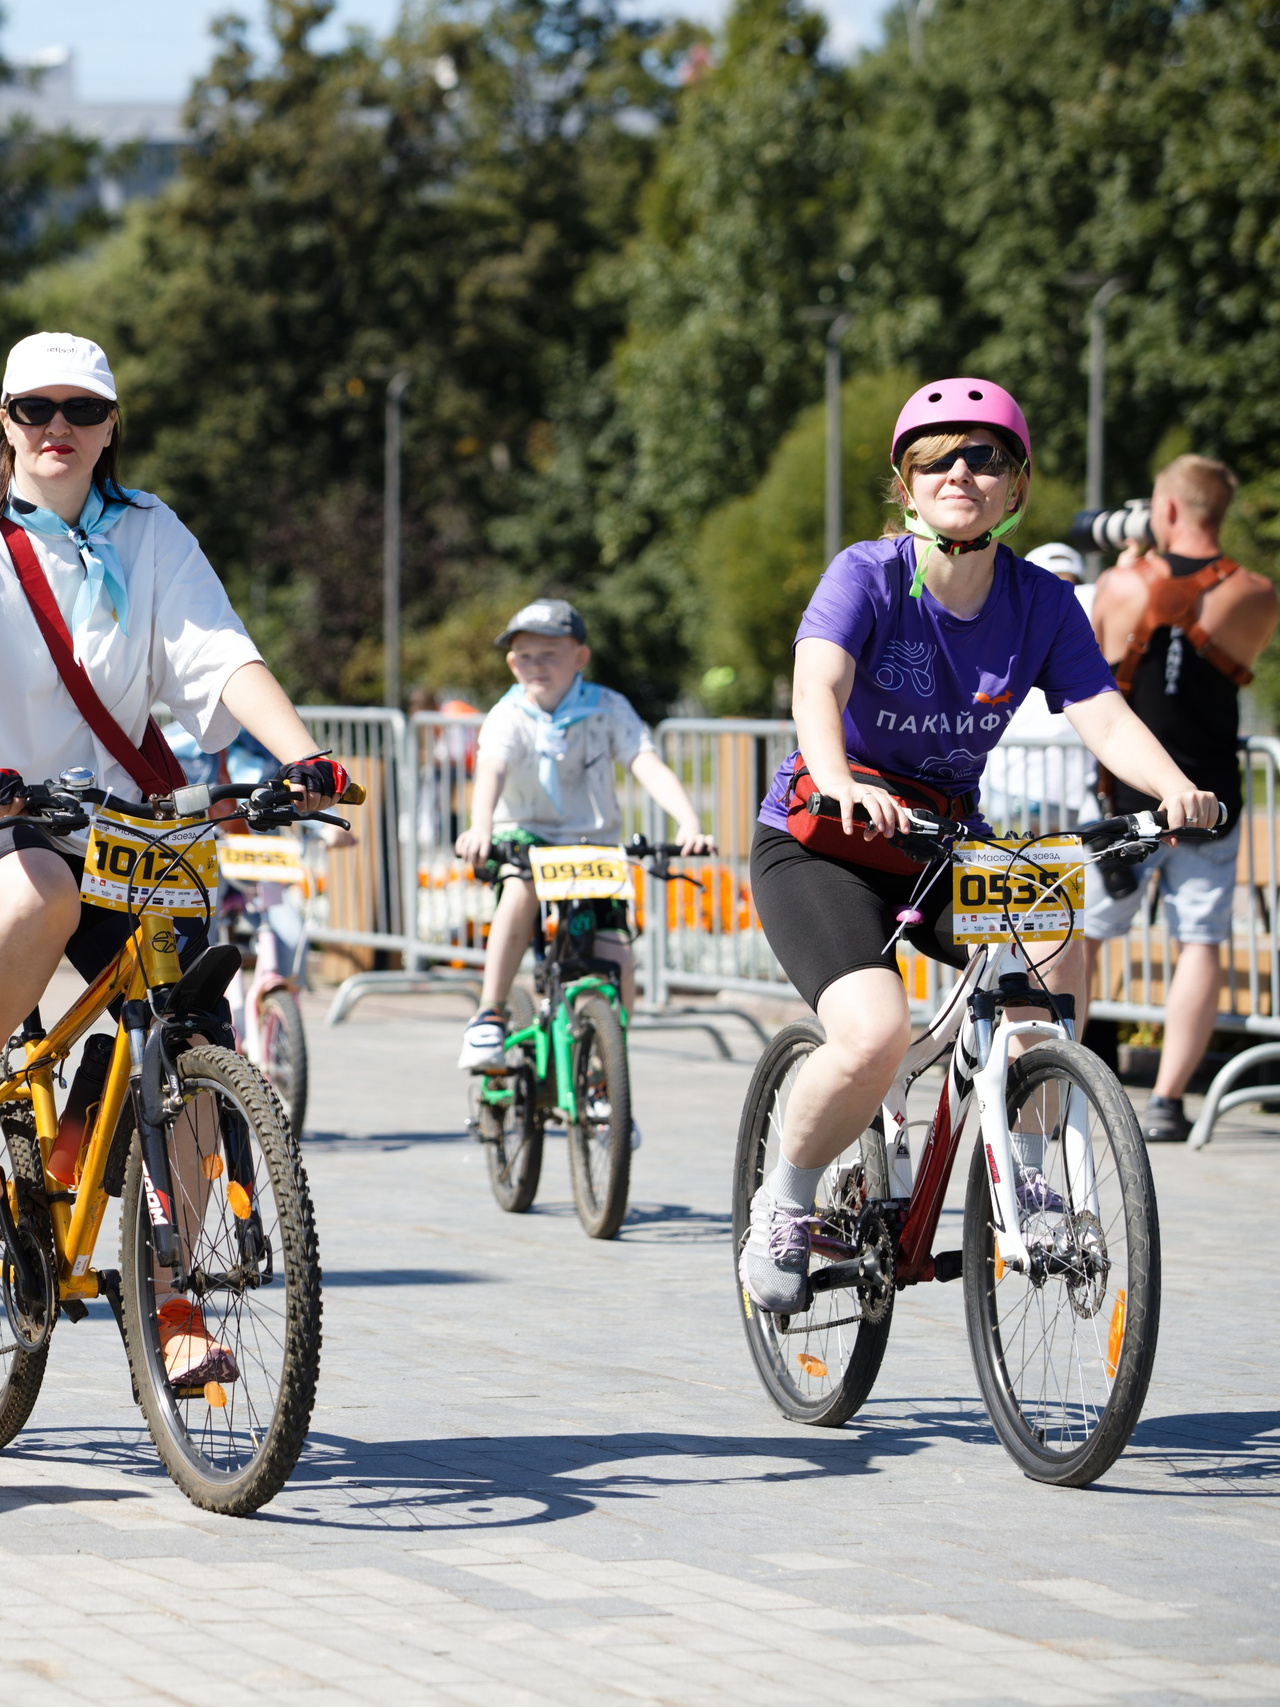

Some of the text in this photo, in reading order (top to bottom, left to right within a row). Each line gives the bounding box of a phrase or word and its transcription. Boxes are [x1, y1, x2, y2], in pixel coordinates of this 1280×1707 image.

[94, 840, 180, 881] 1012
[977, 852, 1031, 863] Массой
[1032, 852, 1061, 861] заезд
[960, 872, 1062, 906] 0535
